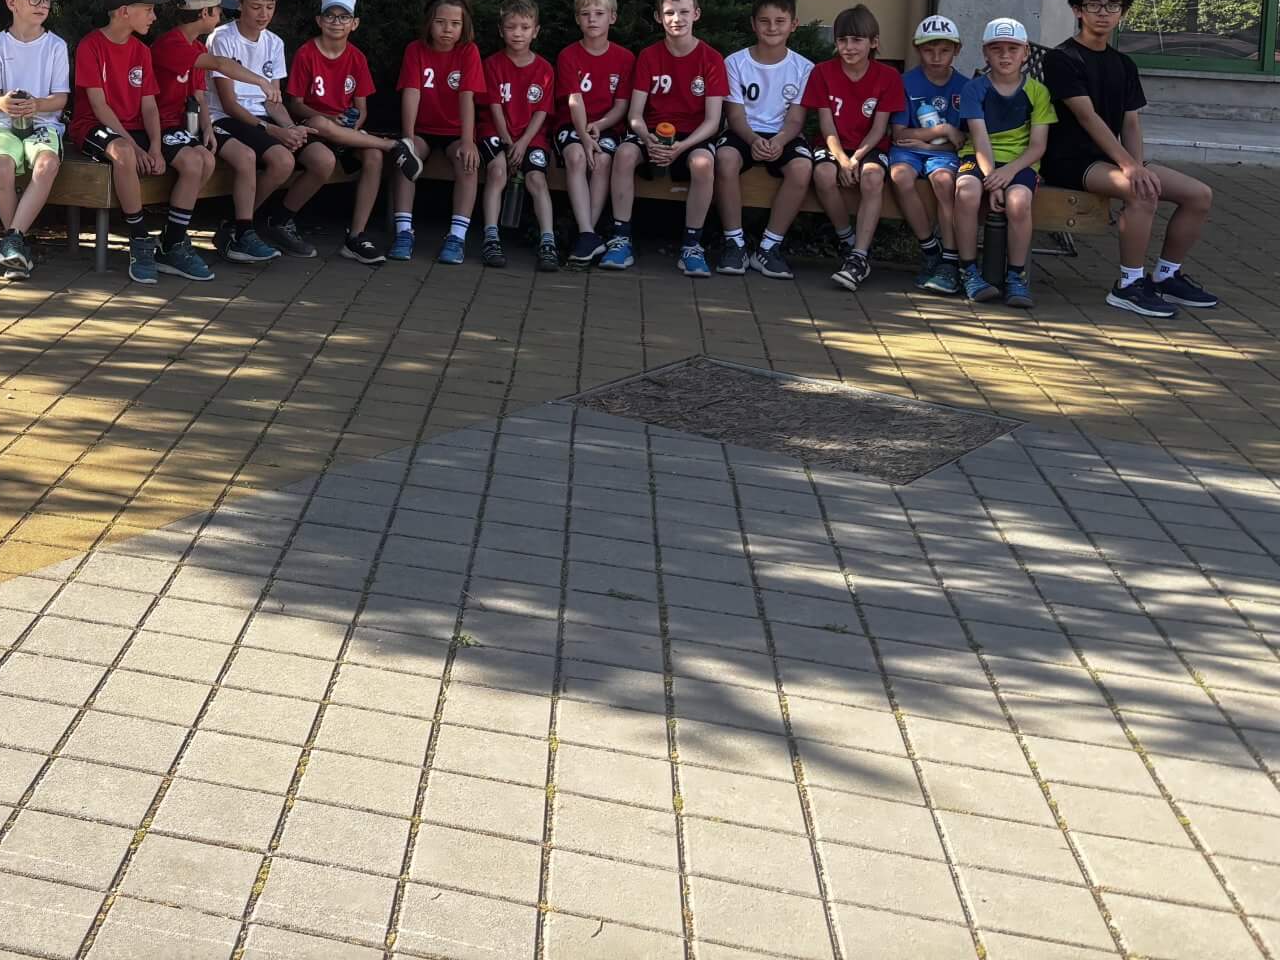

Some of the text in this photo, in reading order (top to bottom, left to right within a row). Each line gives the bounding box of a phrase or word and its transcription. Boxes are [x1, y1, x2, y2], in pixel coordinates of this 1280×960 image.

[922, 21, 952, 33] VLK
[423, 68, 434, 88] 2
[651, 75, 672, 94] 79
